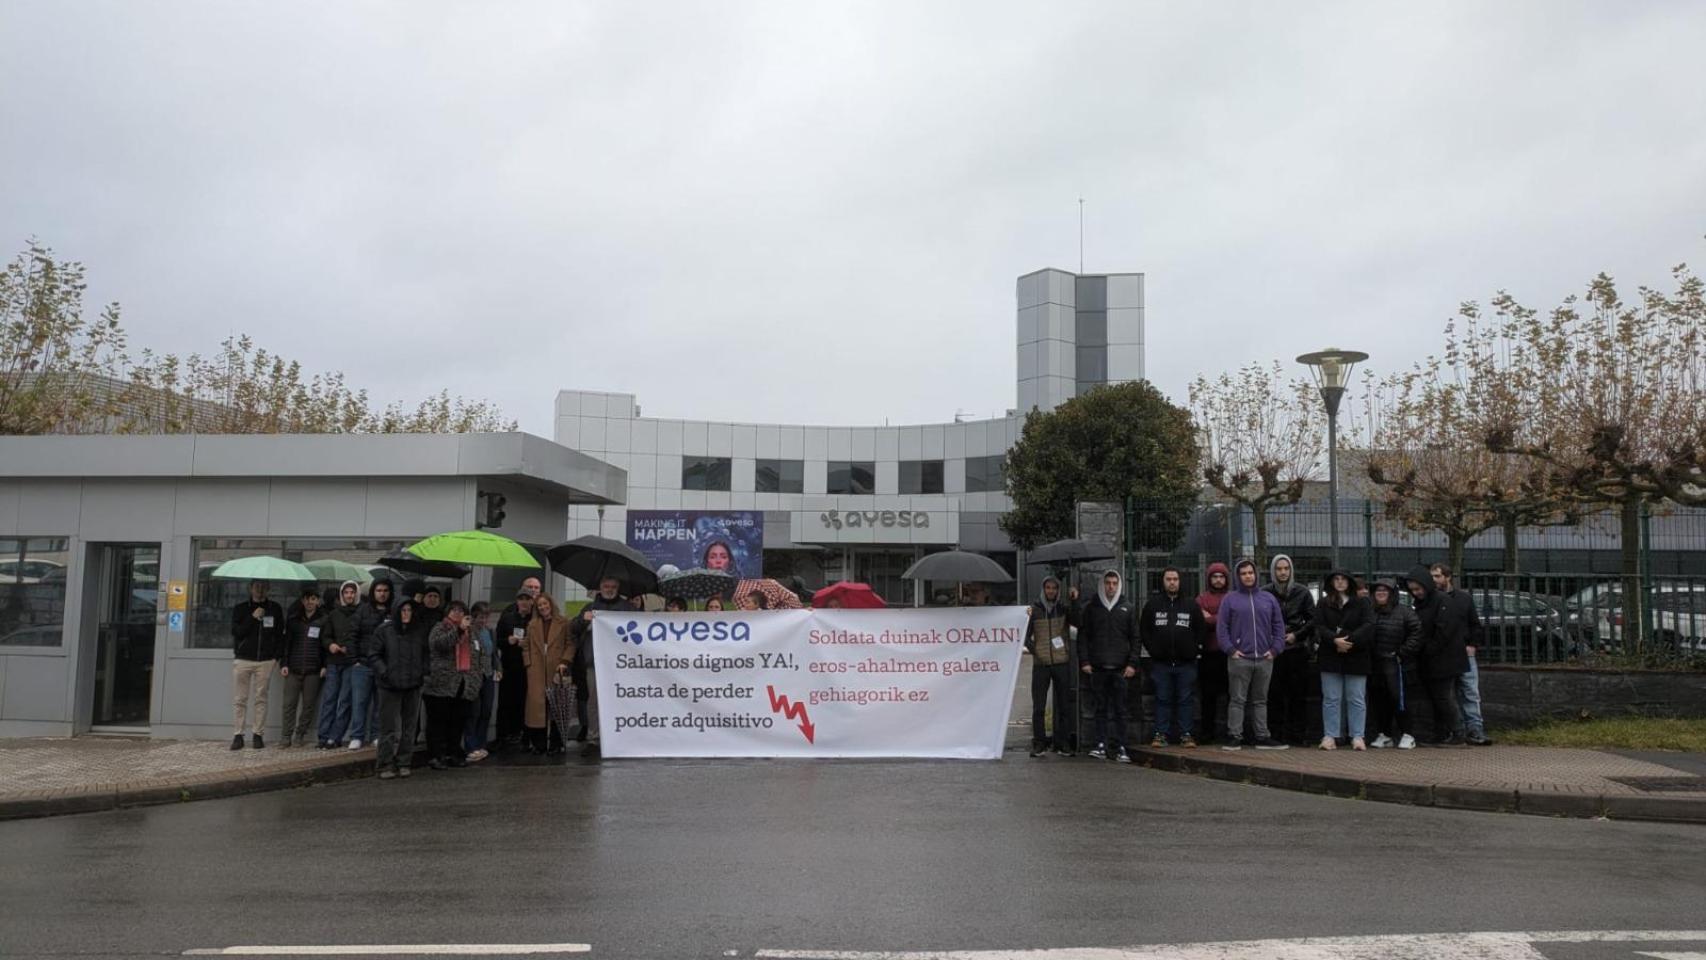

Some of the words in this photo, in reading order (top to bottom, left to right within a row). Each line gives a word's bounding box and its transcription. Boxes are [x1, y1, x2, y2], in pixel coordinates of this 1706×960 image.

[634, 519, 674, 528] MAKING
[677, 519, 687, 528] IT
[845, 510, 930, 529] ayesa
[634, 528, 697, 541] HAPPEN
[647, 621, 750, 641] ayesa
[808, 630, 875, 645] Soldata
[879, 629, 943, 644] duinak
[946, 627, 1021, 644] ORAIN!
[615, 653, 690, 670] Salarios
[693, 653, 755, 673] dignos
[758, 652, 800, 671] YA!,
[808, 658, 939, 674] eros-ahalmen
[942, 657, 1001, 677] galera
[614, 683, 665, 699] basta
[667, 683, 689, 699] de
[691, 683, 755, 703] perder
[808, 687, 905, 706] gehiagorik
[908, 690, 930, 702] ez
[614, 712, 669, 733] poder
[671, 712, 774, 733] adquisitivo
